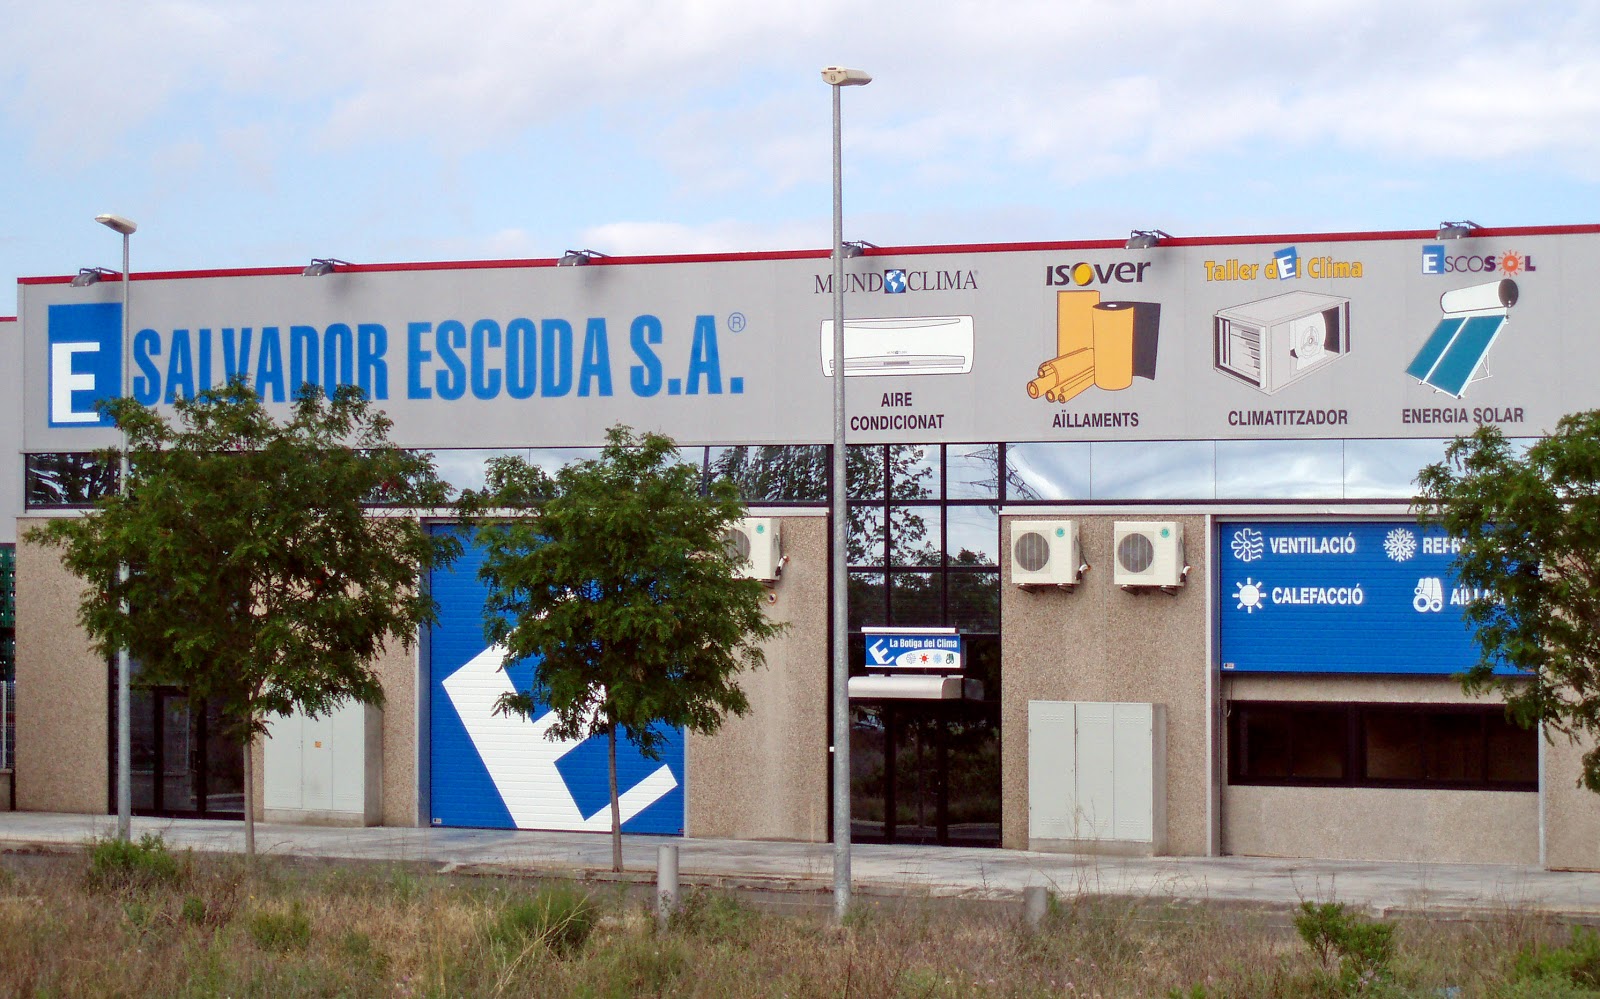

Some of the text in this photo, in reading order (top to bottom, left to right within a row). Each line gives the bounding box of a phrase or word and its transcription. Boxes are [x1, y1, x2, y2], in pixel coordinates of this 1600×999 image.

[1204, 260, 1259, 281] Taller
[1308, 256, 1363, 279] Clima
[133, 323, 388, 406] SALVADOR
[407, 318, 613, 400] ESCODA
[629, 314, 744, 398] S.A.
[881, 392, 912, 407] AIRE
[850, 414, 945, 431] CONDICIONAT
[1052, 410, 1139, 428] AÏLLAMENTS
[1228, 409, 1348, 426] CLIMATITZADOR
[1402, 407, 1524, 424] ENERGIA SOLAR
[1269, 532, 1356, 554] VENTILACIÓ
[1271, 584, 1363, 605] CALEFACCIÓ
[889, 638, 957, 649] La Botiga del Clima
